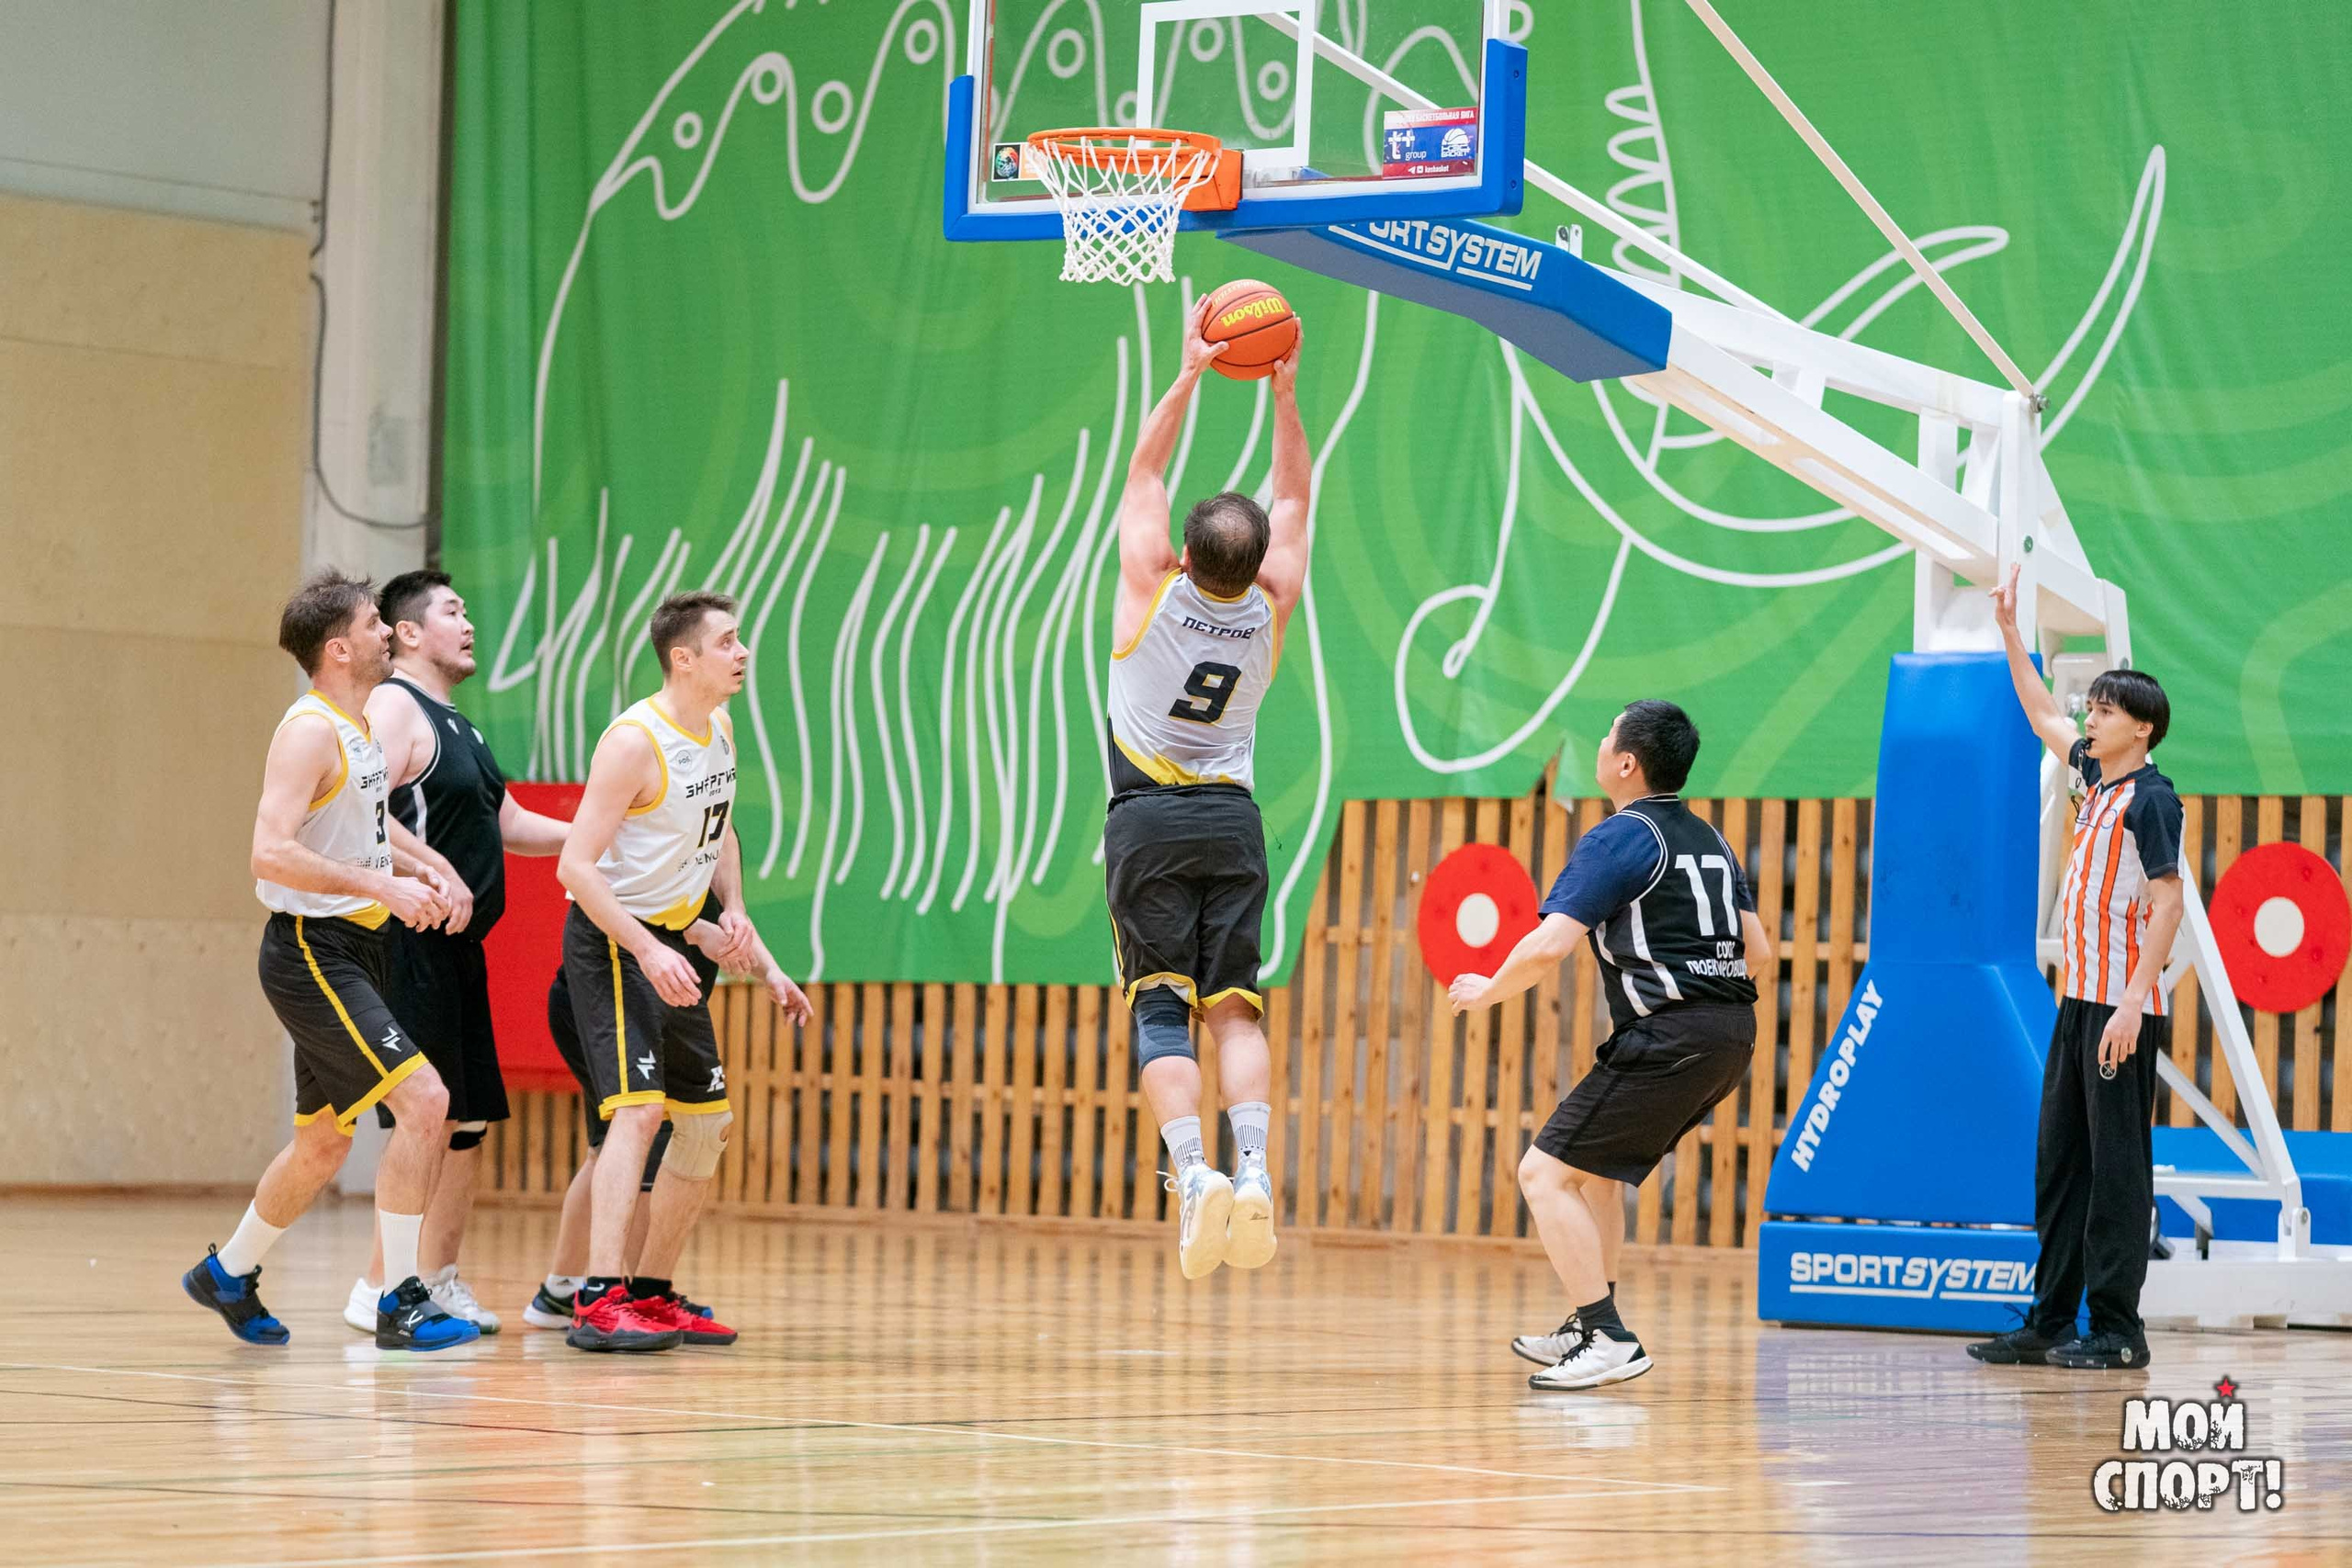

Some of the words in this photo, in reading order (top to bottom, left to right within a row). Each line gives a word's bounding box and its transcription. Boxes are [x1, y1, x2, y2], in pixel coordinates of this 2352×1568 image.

[1405, 151, 1427, 161] group
[1220, 297, 1285, 327] Wilson
[1182, 616, 1256, 639] ПЕТРОВ
[1168, 660, 1242, 726] 9
[696, 799, 731, 849] 13
[1675, 854, 1738, 937] 17
[1791, 979, 1883, 1173] HYDROPLAY
[1790, 1252, 2037, 1299] SPORTSYSTEM
